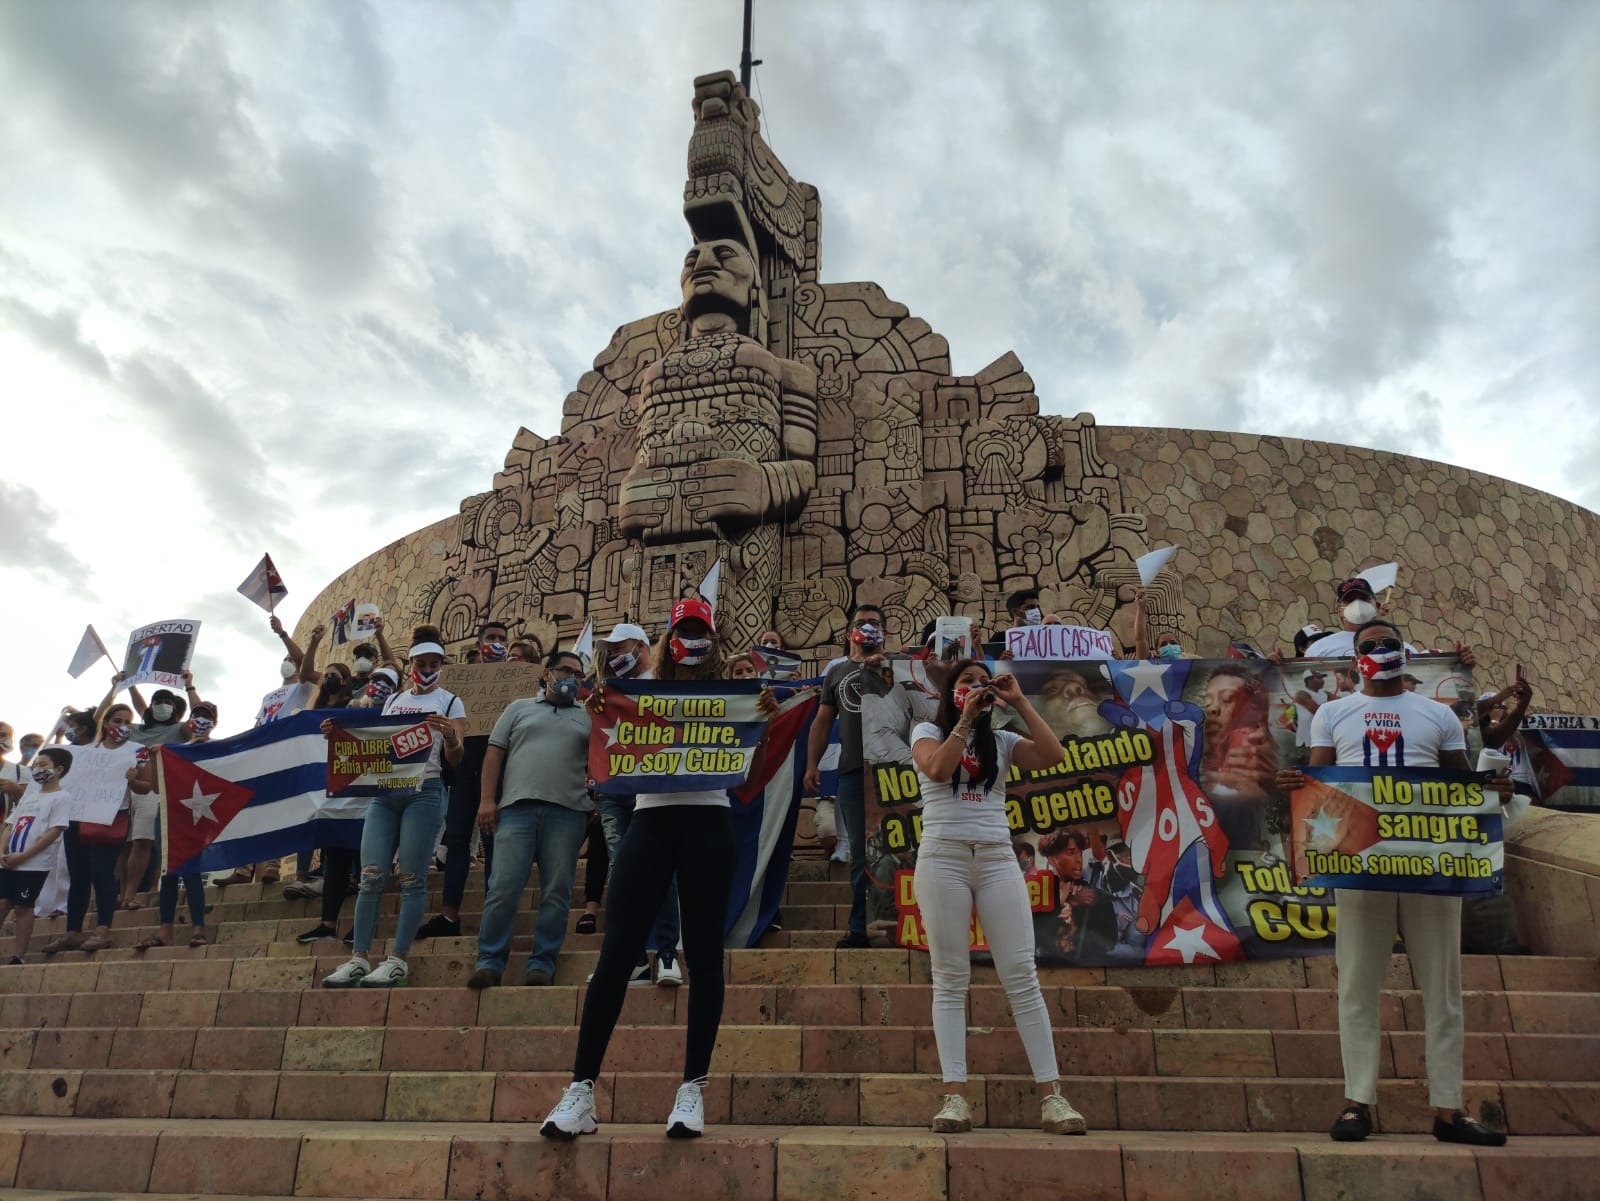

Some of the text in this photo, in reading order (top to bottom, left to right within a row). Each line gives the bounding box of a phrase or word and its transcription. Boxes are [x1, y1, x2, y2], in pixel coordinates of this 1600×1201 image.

[133, 623, 194, 642] LIBERTAD
[1008, 626, 1058, 659] RAÚL
[637, 694, 726, 718] Por una
[1364, 712, 1401, 720] PATRIA
[618, 721, 741, 748] Cuba libre,
[1364, 720, 1401, 728] Y VIDA
[1521, 715, 1587, 729] PATRIA
[334, 739, 390, 756] CUBA LIBRE
[397, 727, 429, 753] SOS
[333, 757, 393, 776] Patria y vida
[608, 748, 745, 777] yo soy Cuba
[877, 766, 919, 802] No
[1031, 729, 1153, 778] atando
[961, 792, 983, 802] SOS
[1372, 775, 1485, 807] No mas
[1030, 782, 1115, 831] gente
[1376, 813, 1489, 845] sangre,
[1305, 850, 1493, 879] Todos somos Cuba
